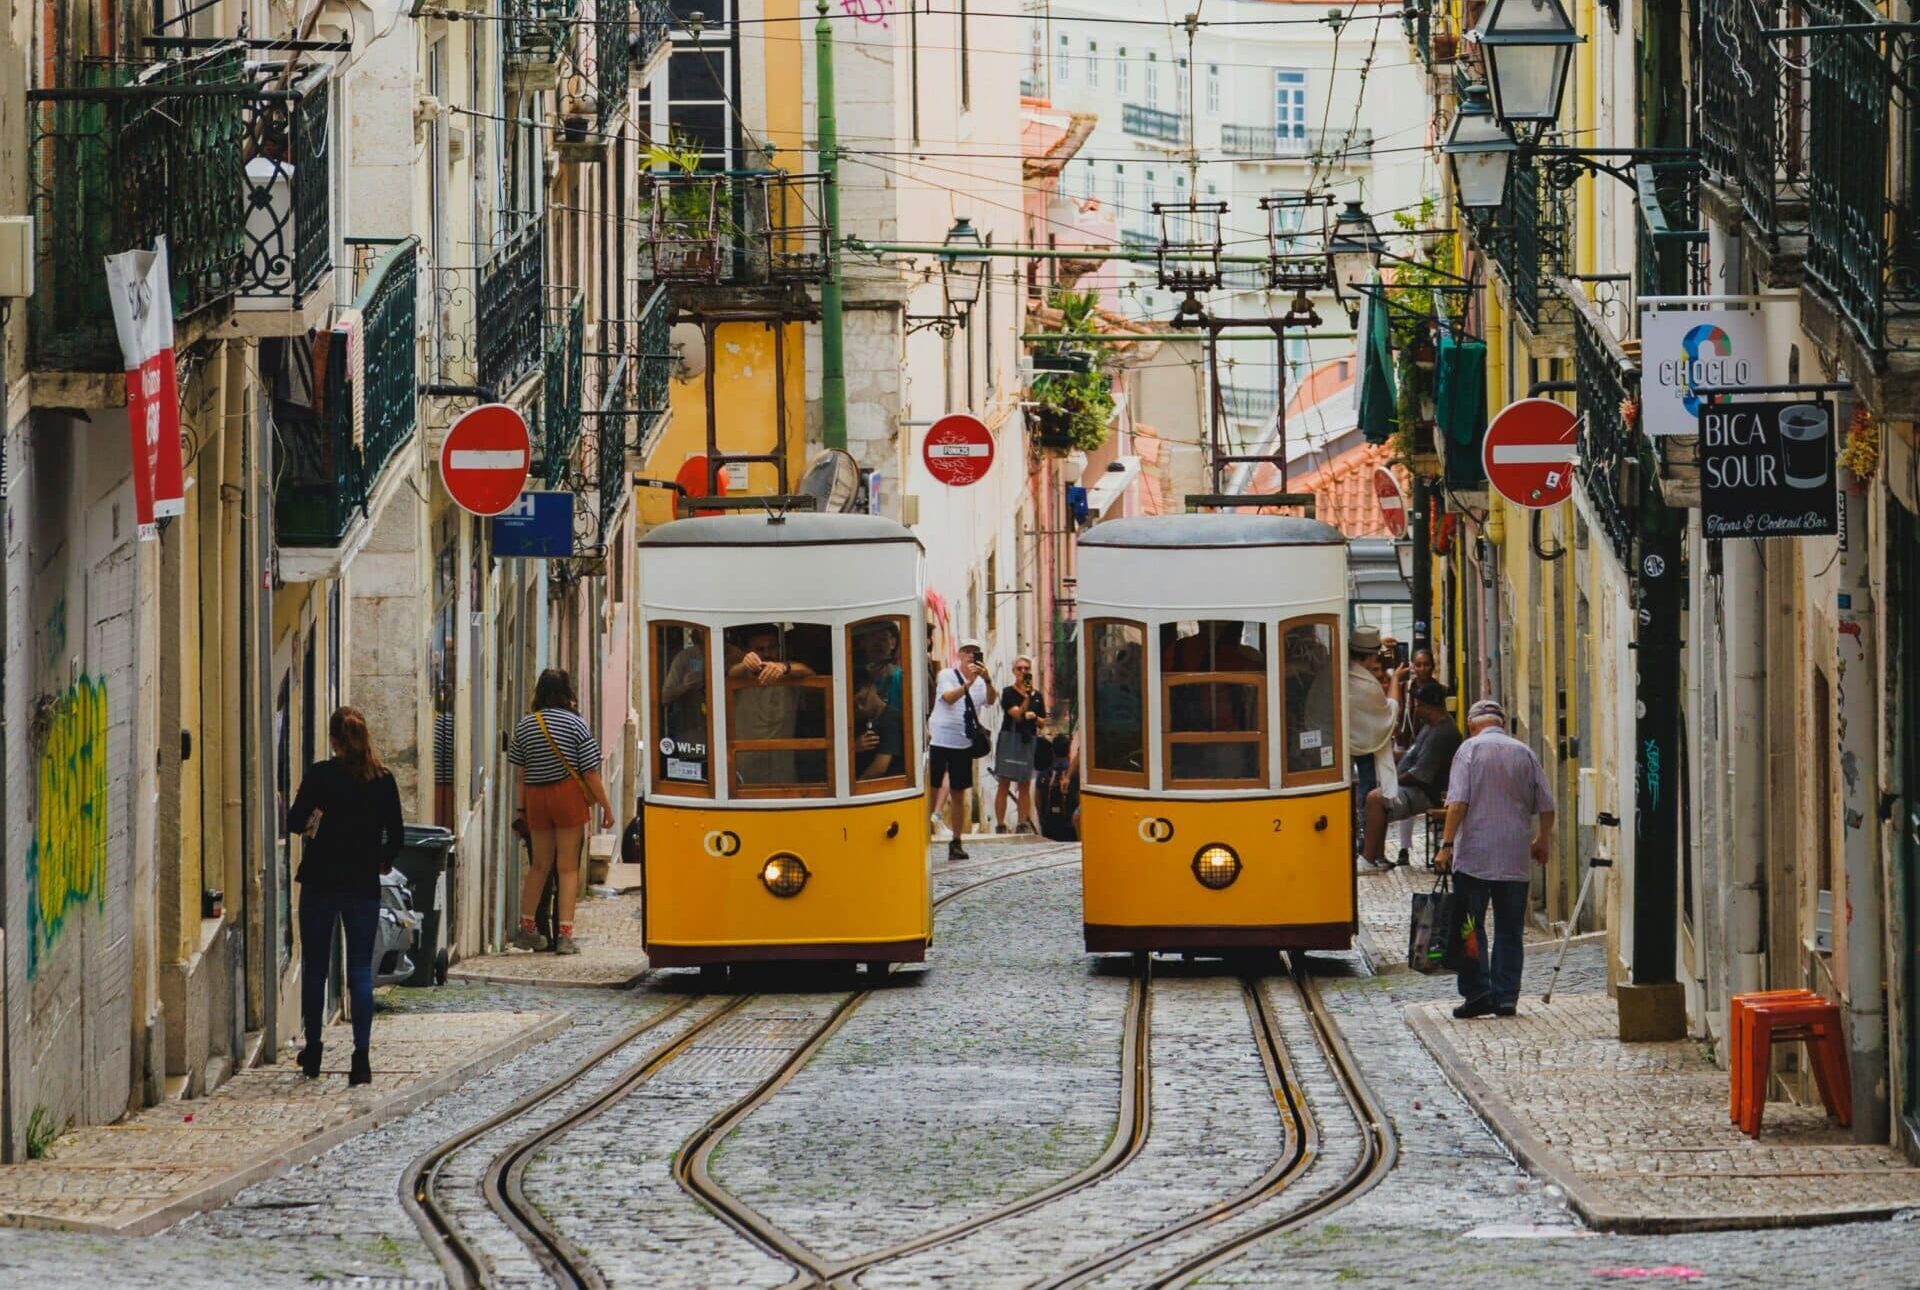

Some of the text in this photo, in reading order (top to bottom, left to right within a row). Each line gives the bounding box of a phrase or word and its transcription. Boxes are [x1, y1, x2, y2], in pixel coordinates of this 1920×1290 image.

[1659, 359, 1751, 386] CHOCLO
[1705, 413, 1767, 447] BICA
[1706, 454, 1777, 488] SOUR
[1706, 511, 1829, 534] Tapas & Cocktail Bar
[677, 742, 706, 755] WI-FI
[843, 827, 848, 842] 1
[1272, 819, 1282, 832] 2
